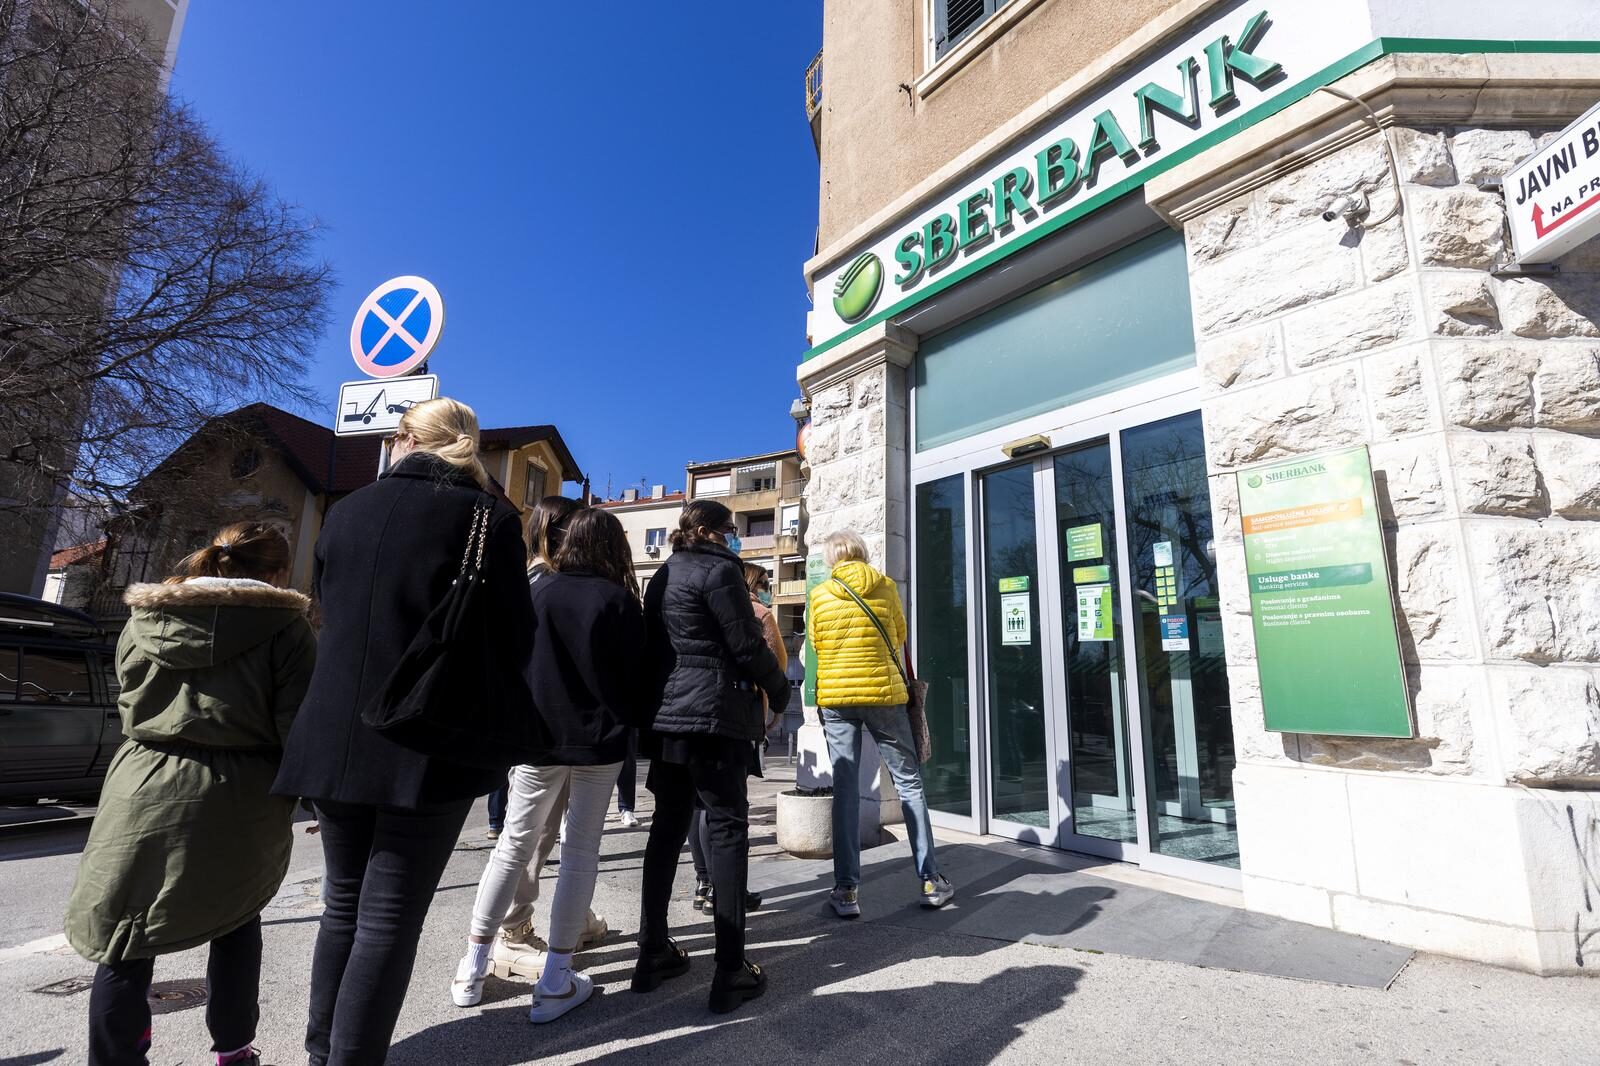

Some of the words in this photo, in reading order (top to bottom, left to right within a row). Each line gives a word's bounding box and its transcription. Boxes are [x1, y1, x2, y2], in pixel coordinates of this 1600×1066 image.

[894, 9, 1282, 286] SBERBANK
[1516, 142, 1577, 205] JAVNI
[1582, 121, 1600, 159] B
[1551, 195, 1574, 217] NA
[1266, 463, 1326, 481] SBERBANK
[1258, 575, 1288, 584] Usluge
[1290, 572, 1320, 580] banke
